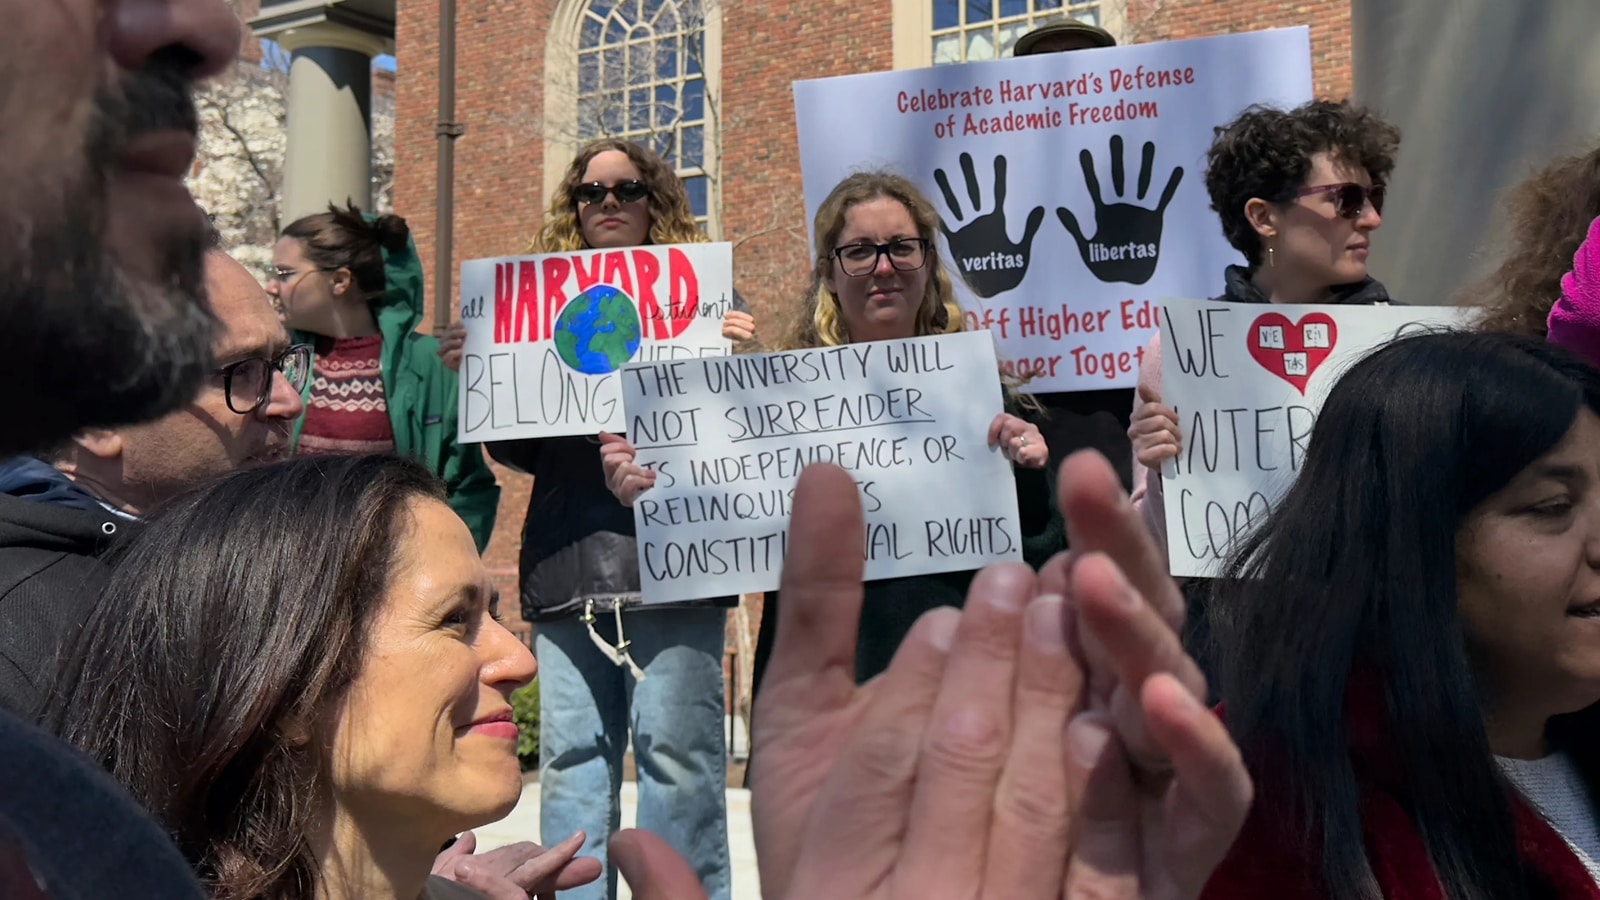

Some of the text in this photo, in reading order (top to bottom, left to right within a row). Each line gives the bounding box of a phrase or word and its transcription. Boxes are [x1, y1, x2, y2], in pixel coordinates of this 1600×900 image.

[897, 65, 1195, 113] Celebrate Harvard's Defense
[934, 99, 1158, 139] of Academic Freedom
[963, 252, 1024, 271] veritas
[1089, 242, 1156, 262] libertas
[461, 296, 485, 319] all
[494, 247, 698, 344] HARVARD
[1019, 304, 1111, 340] Higher
[1164, 305, 1231, 378] WE
[465, 348, 617, 434] BELONG
[624, 362, 688, 397] THE
[704, 345, 872, 394] UNIVERSITY
[887, 341, 954, 374] WILL
[633, 388, 932, 444] NOT SURRENDER
[923, 435, 965, 463] OR
[925, 517, 1017, 558] RIGHTS.
